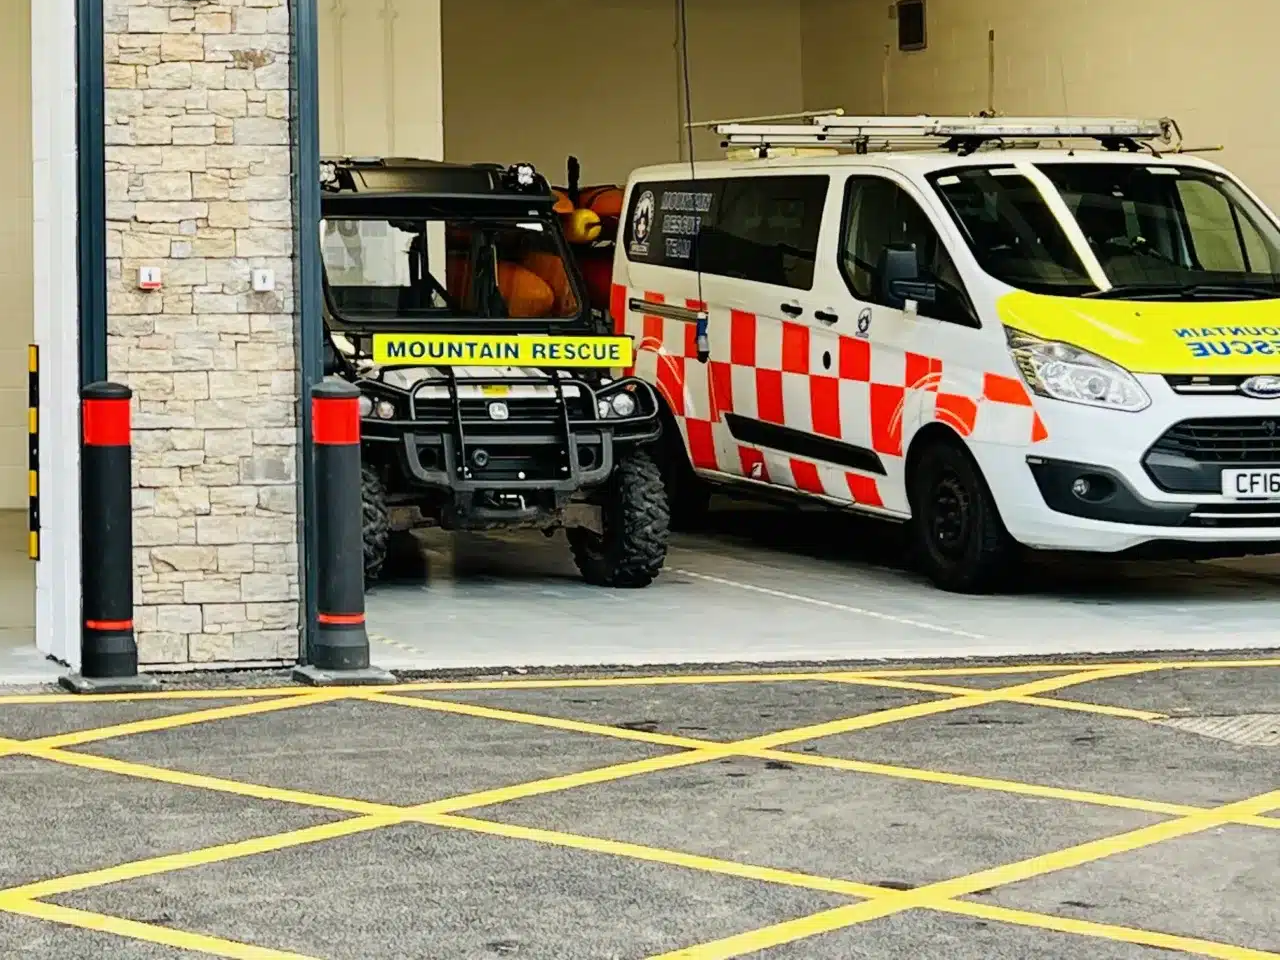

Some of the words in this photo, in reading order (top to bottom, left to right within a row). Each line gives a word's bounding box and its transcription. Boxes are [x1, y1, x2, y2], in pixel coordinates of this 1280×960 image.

[386, 341, 520, 359] MOUNTAIN
[532, 343, 621, 360] RESCUE
[1236, 473, 1280, 493] CF16
